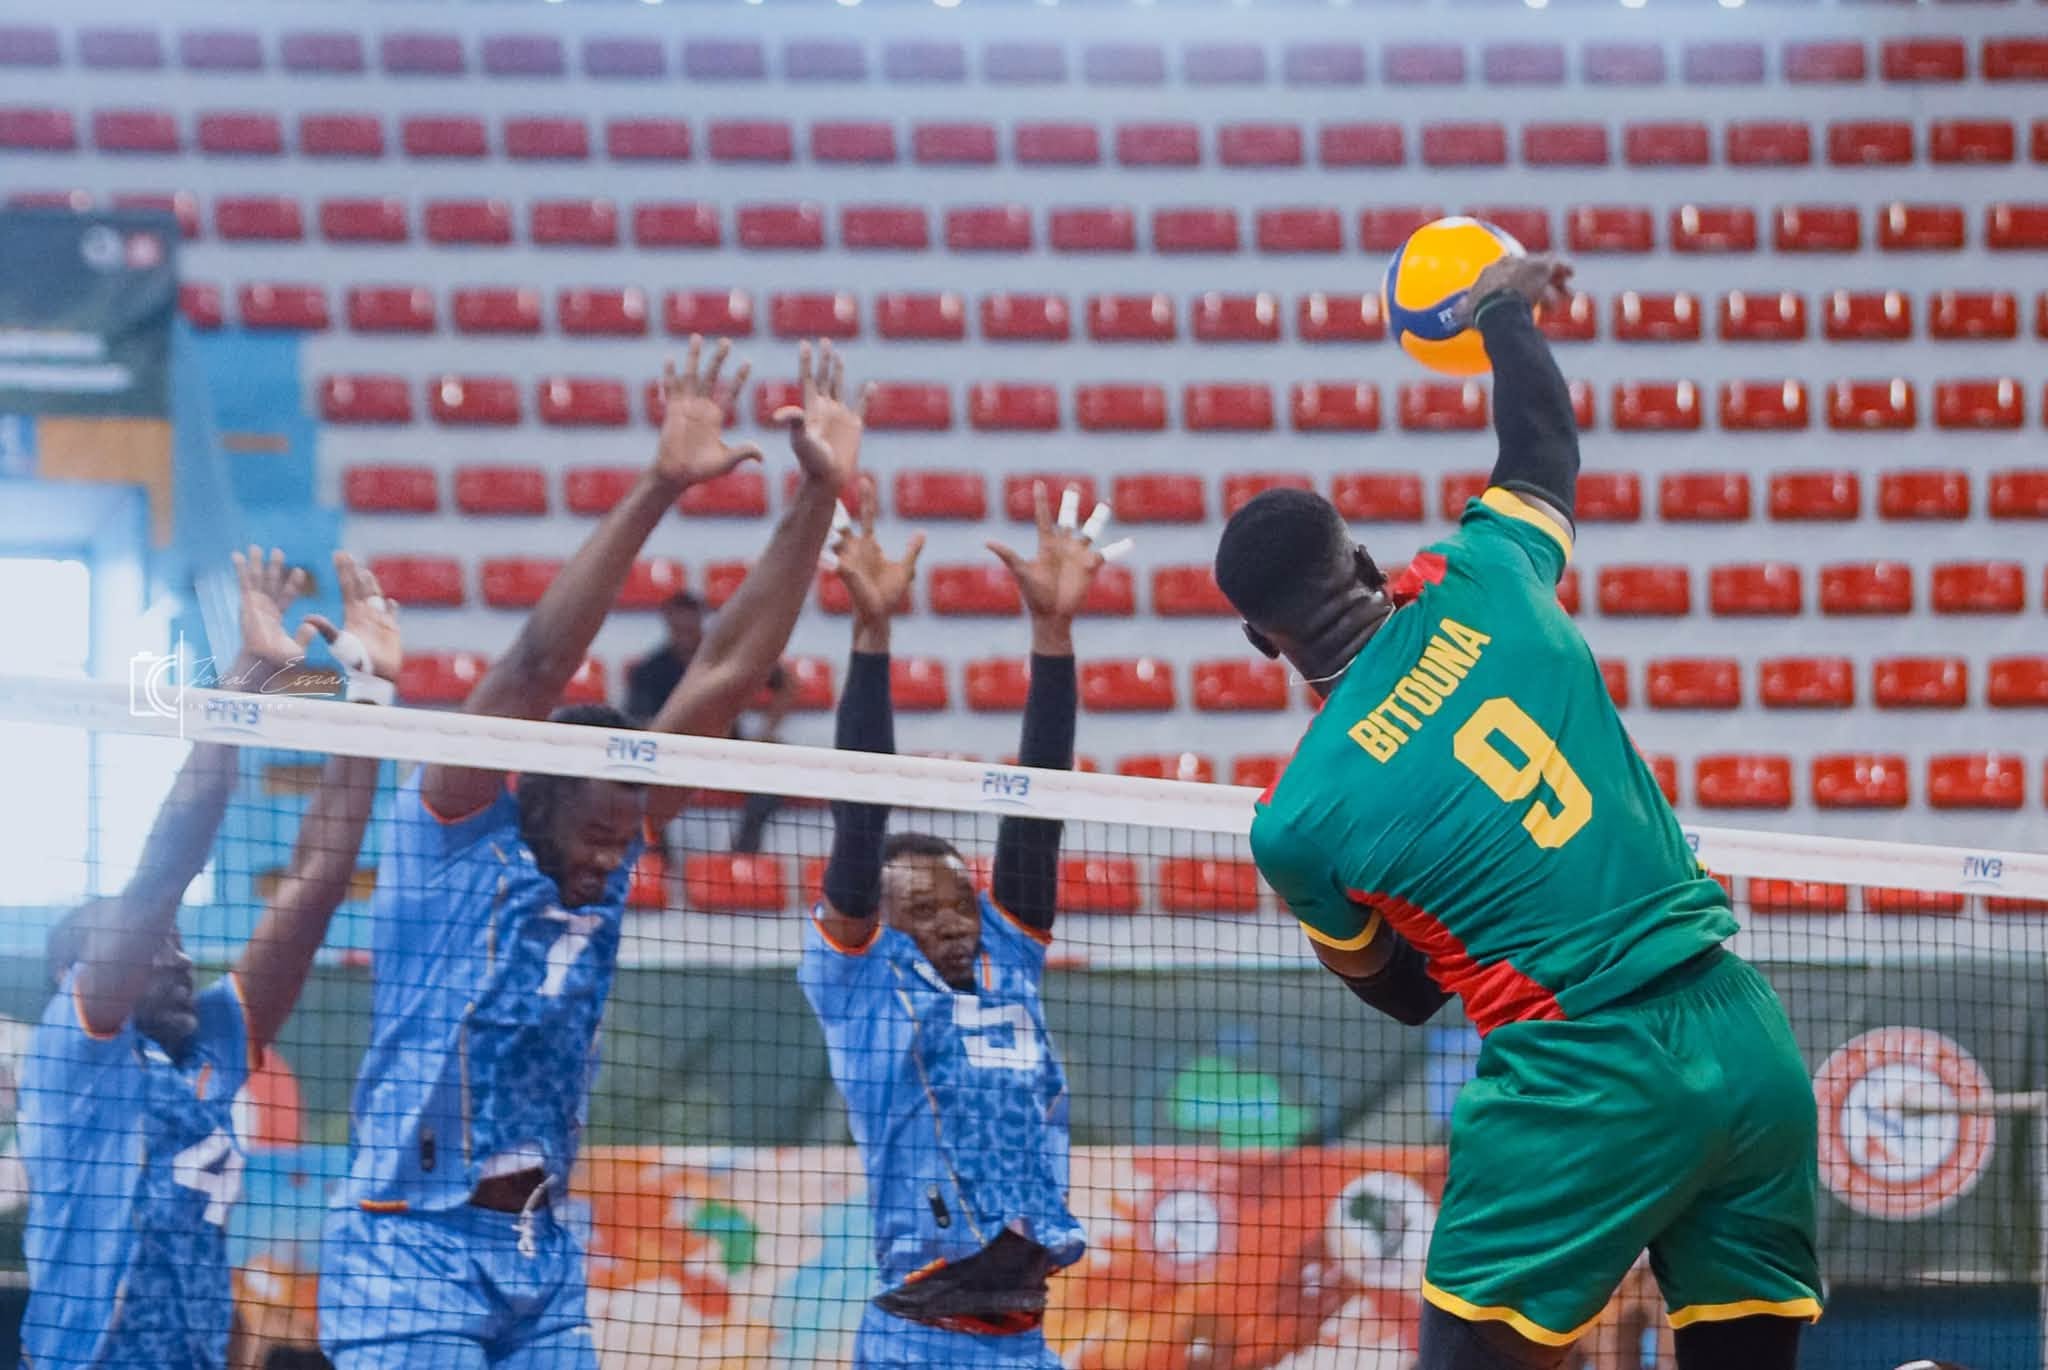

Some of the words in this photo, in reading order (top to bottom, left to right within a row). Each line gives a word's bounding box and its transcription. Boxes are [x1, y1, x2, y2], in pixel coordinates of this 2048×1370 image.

[1347, 617, 1492, 764] BITOUNA
[606, 735, 657, 763] FIVB
[982, 771, 1030, 796] FIVB
[1453, 696, 1593, 849] 9
[1962, 855, 2004, 876] FIVB
[951, 994, 1038, 1070] 5
[172, 1126, 247, 1226] 4
